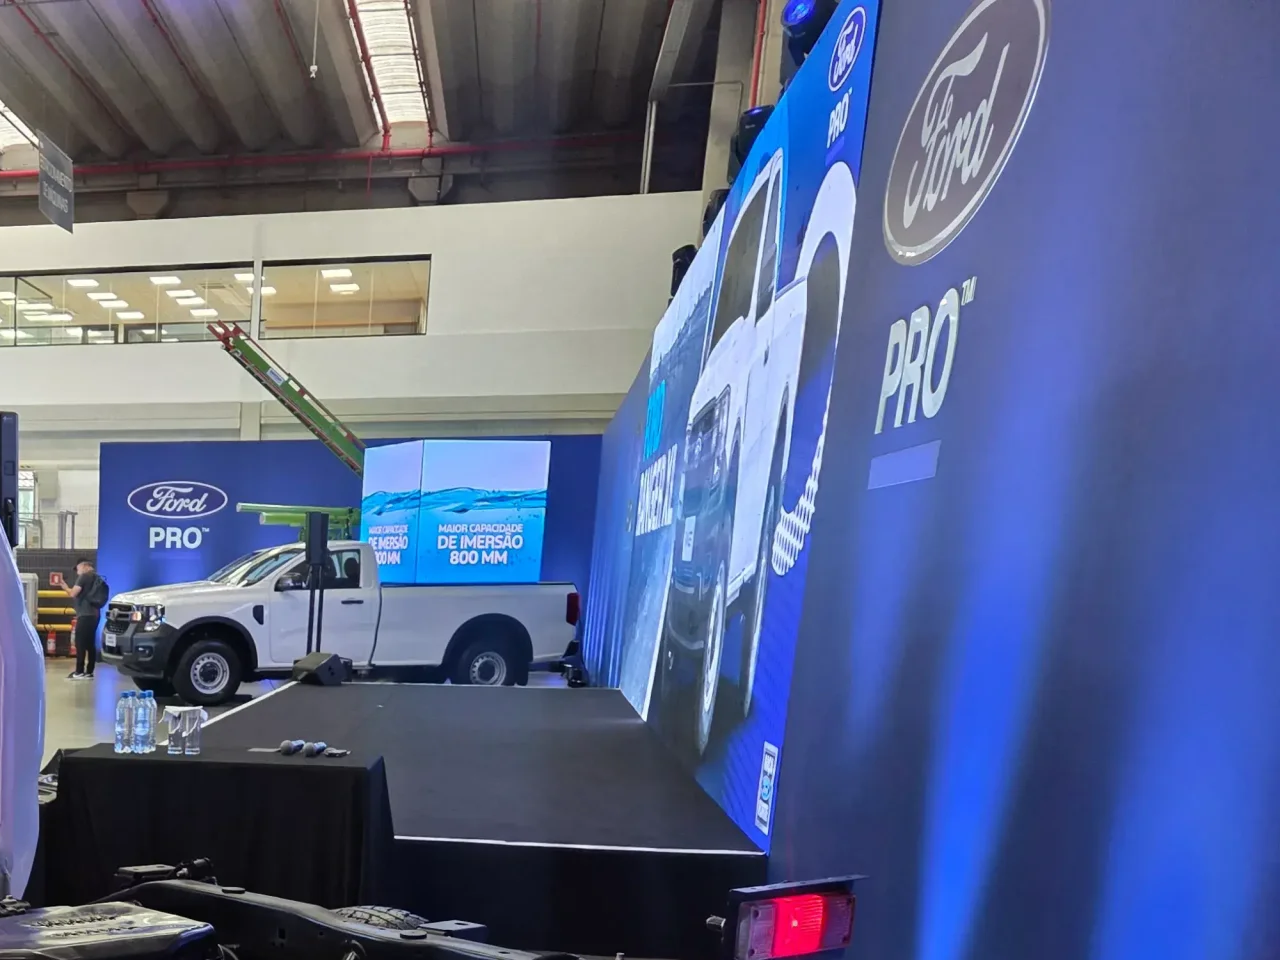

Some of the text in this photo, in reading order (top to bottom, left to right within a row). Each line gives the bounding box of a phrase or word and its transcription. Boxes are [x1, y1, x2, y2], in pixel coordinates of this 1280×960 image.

[833, 20, 859, 84] Ford
[903, 31, 1010, 229] Ford
[146, 486, 209, 512] Ford
[437, 531, 524, 549] DE IMERSÃO
[438, 524, 524, 534] MAIOR CAPACIDADE
[449, 550, 508, 565] 800 MM
